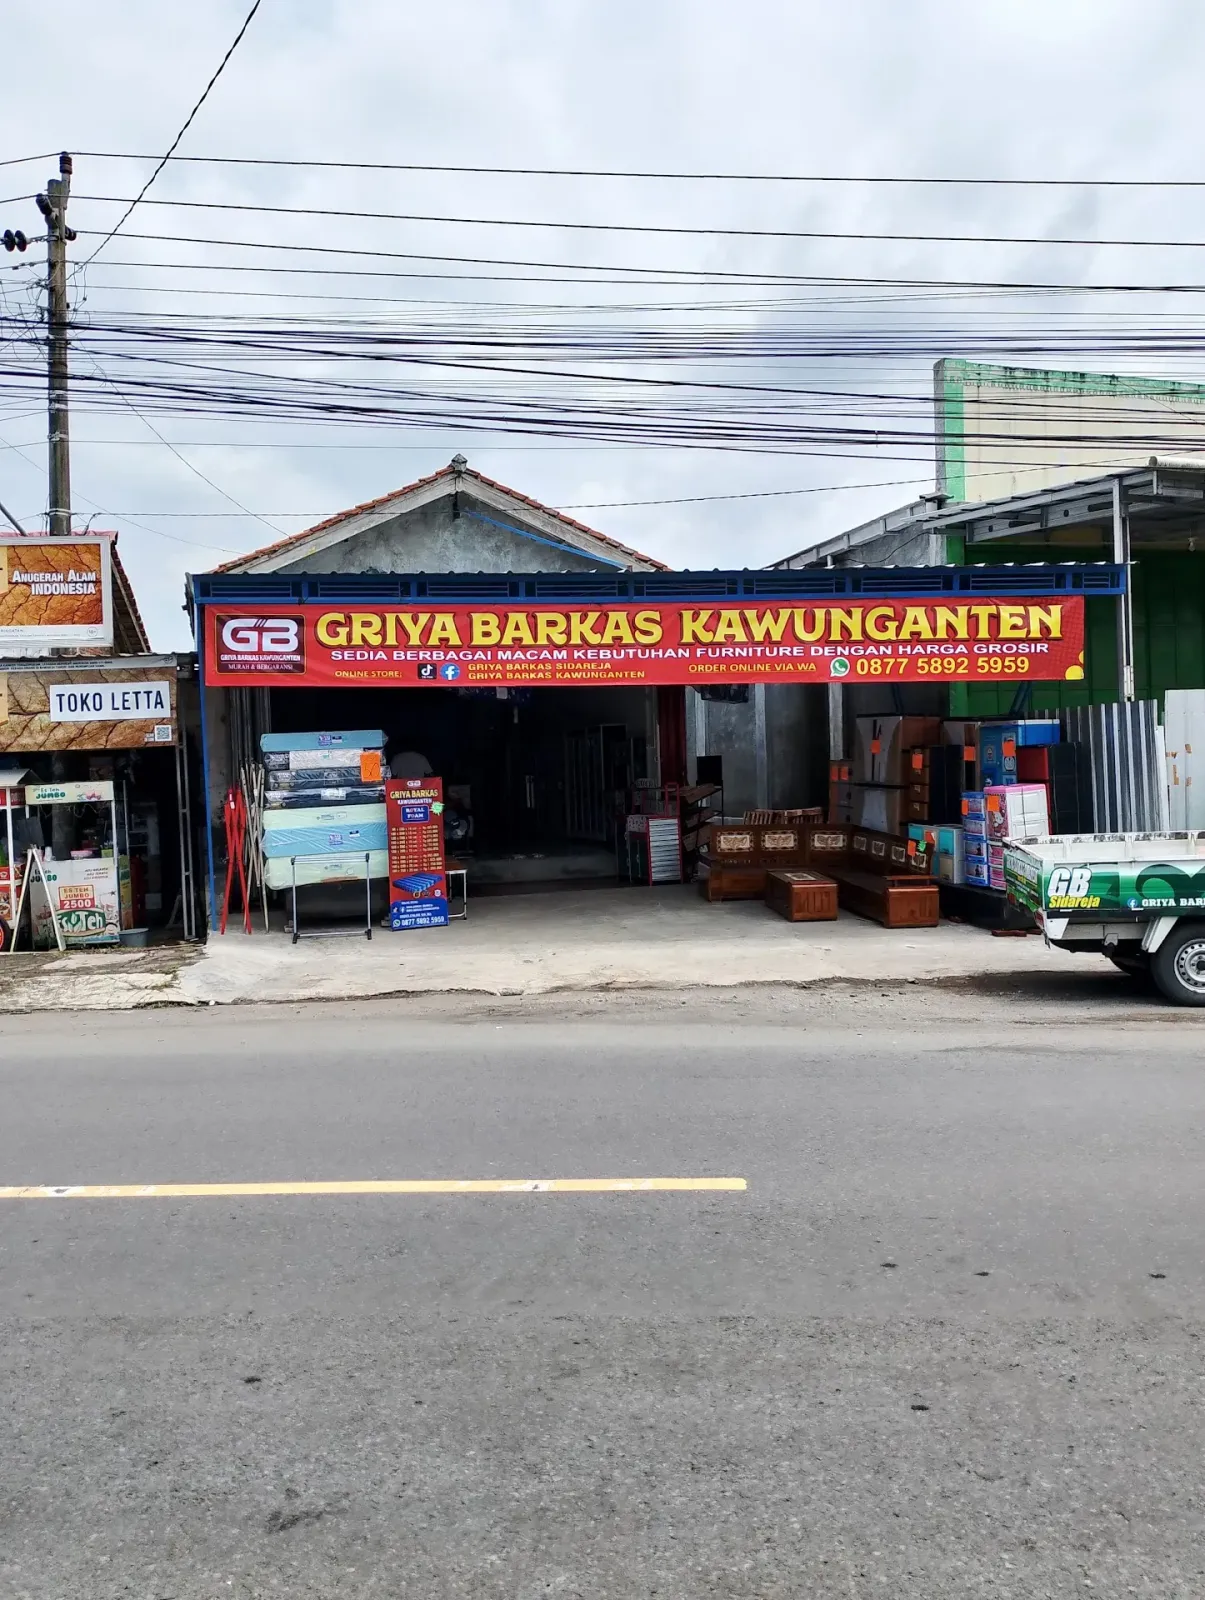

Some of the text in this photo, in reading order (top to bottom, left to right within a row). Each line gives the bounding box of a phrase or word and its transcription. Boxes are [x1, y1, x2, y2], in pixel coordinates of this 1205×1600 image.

[12, 569, 97, 584] ANUGERAH ALAM
[31, 582, 97, 596] INDONESIA
[316, 605, 1064, 647] GRIYA BARKAS KAWUNGANTEN
[222, 618, 299, 652] GB
[331, 642, 1049, 662] SEDIA BERBAGAI MACAM KEBUTUHAN FURNITURE DENGAN HARGA GROSIR
[468, 661, 612, 671] GRIYA BARKAS SIDAREJA
[688, 662, 817, 673] ORDER ONLINE VIA WA
[856, 656, 1030, 675] 0877 5892 5959
[335, 670, 369, 678] ONLINE
[468, 671, 645, 680] GRIYA BARKAS KAWUNGANTEN
[56, 690, 164, 713] TOKO LETTA
[35, 791, 66, 799] JUMBO
[390, 789, 438, 799] GRIYA BARKAS
[1047, 867, 1093, 897] GB
[63, 899, 92, 909] 2500
[1049, 895, 1101, 909] Sidareja
[1141, 898, 1177, 907] GRIYA
